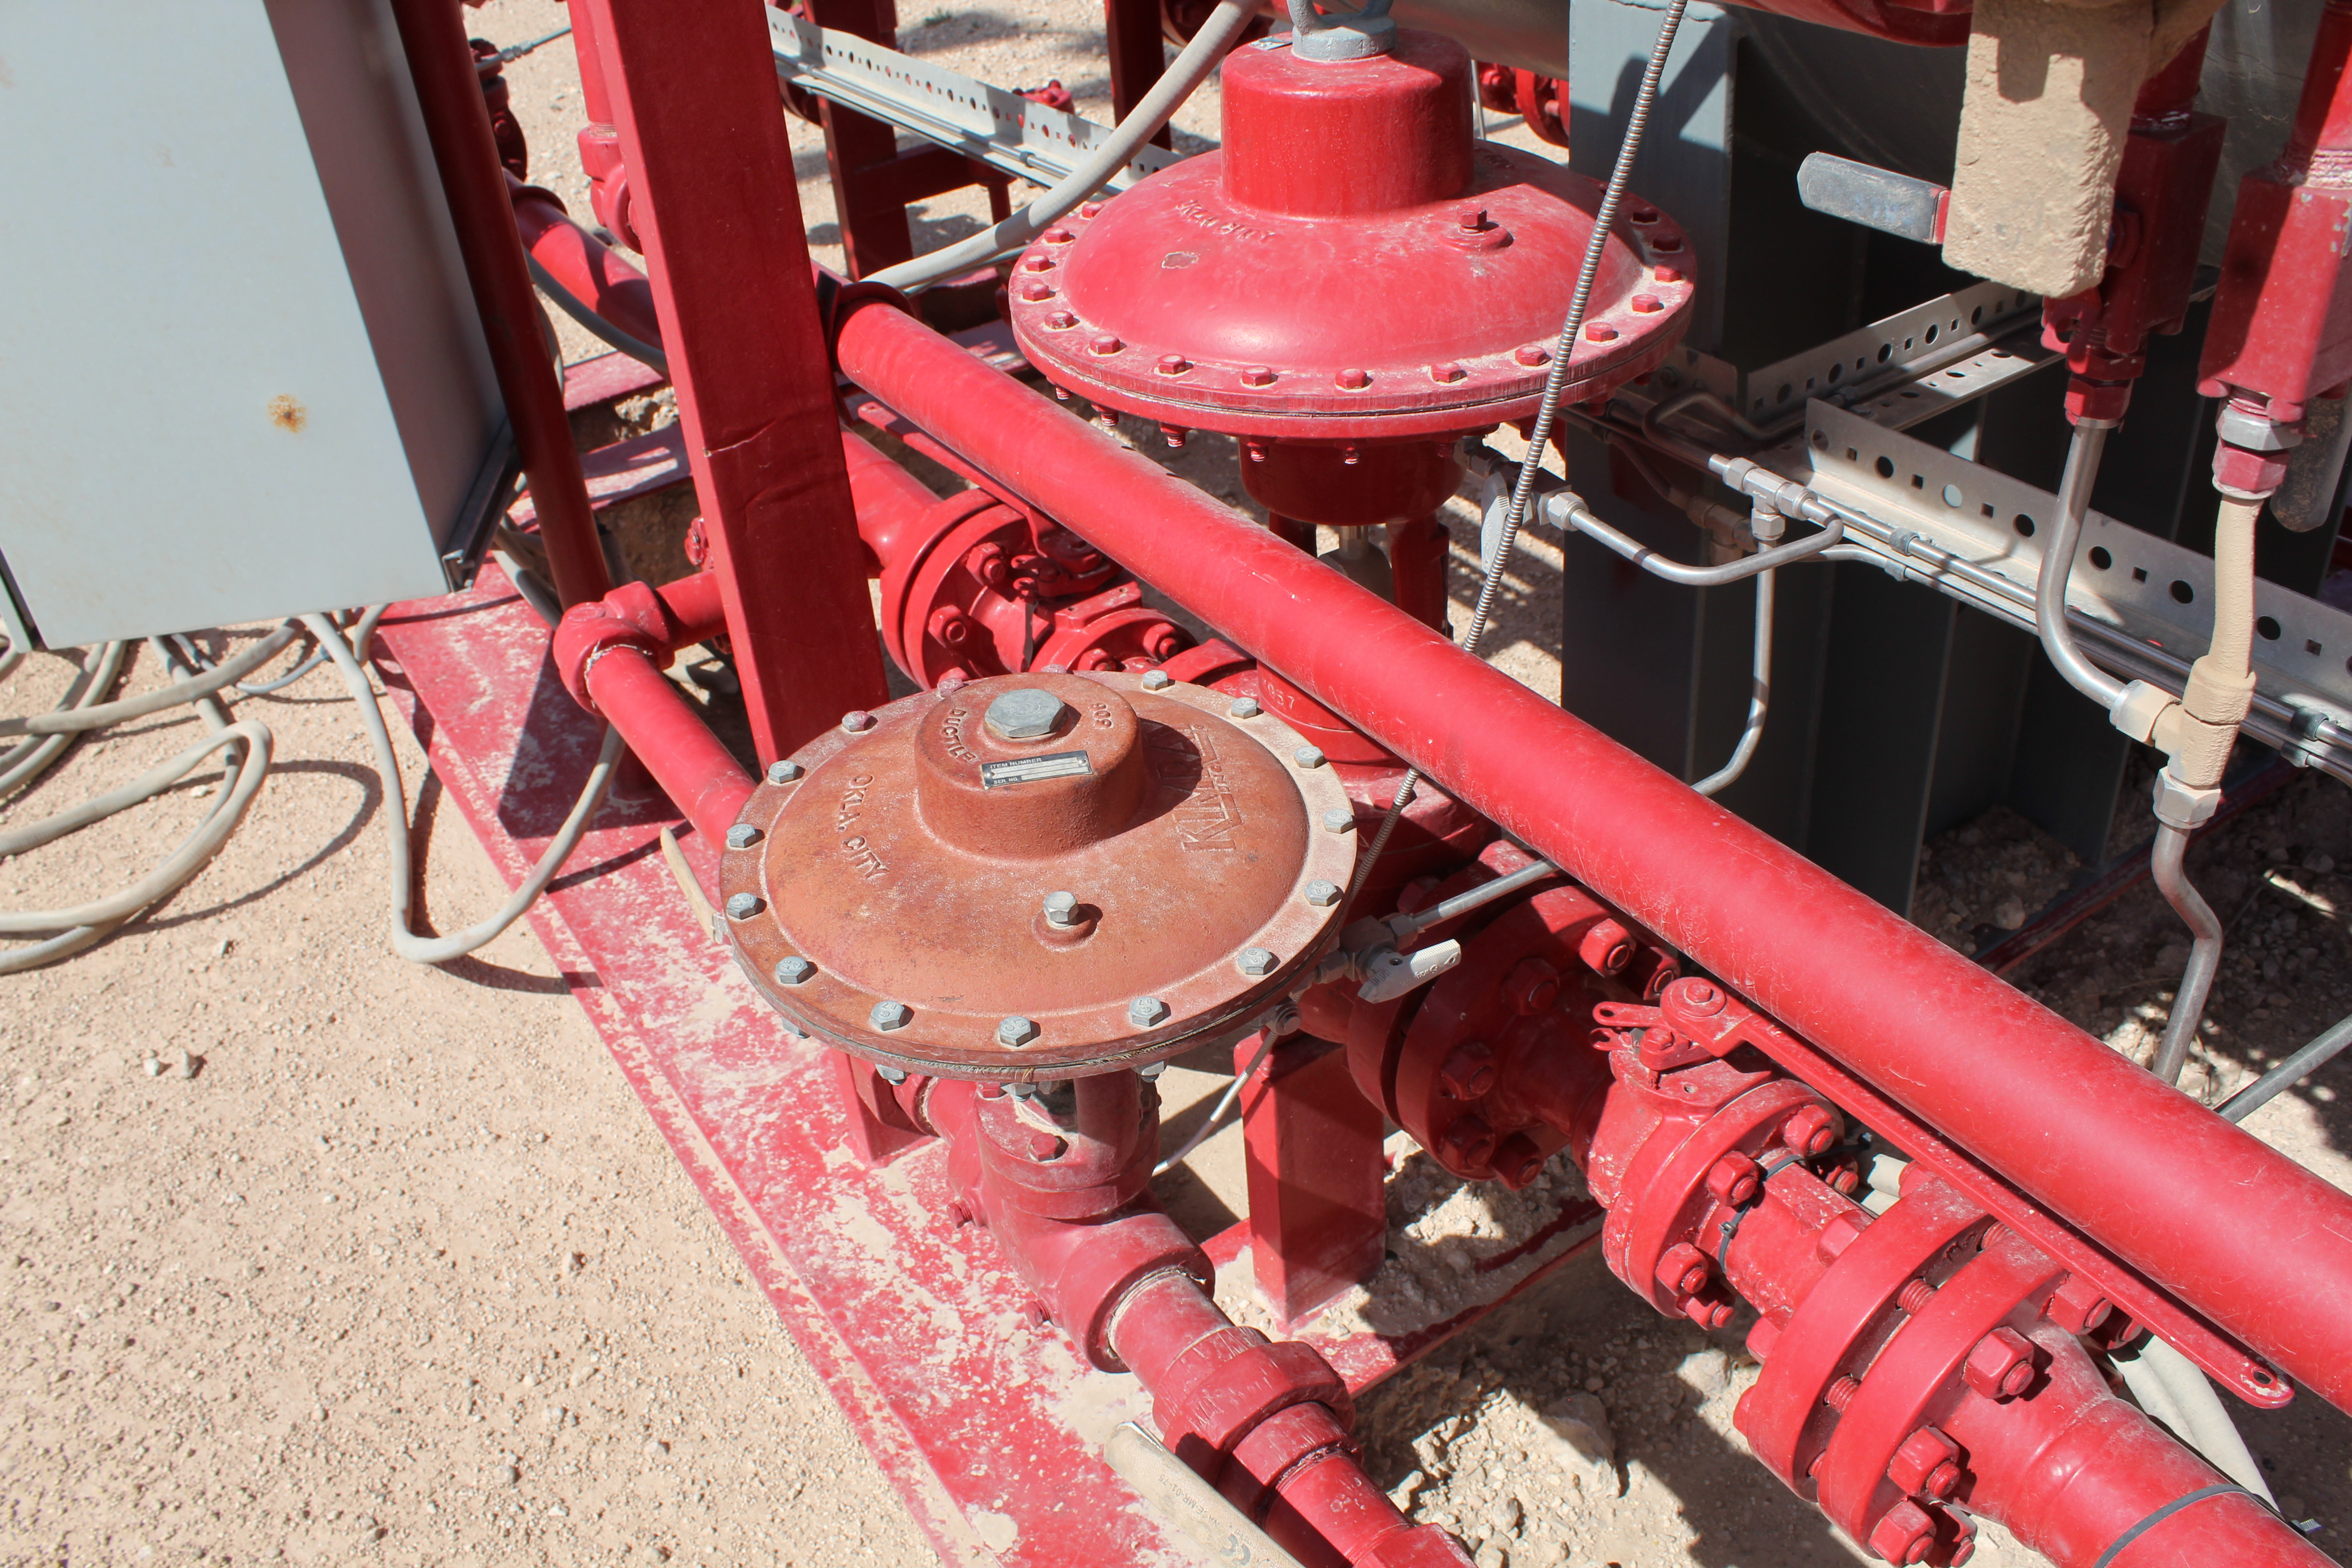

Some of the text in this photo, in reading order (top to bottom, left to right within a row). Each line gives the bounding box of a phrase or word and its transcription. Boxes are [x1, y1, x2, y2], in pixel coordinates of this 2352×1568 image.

[940, 707, 978, 764] DUCTILE
[1009, 757, 1042, 766] NUMBER
[842, 836, 890, 881] CITY
